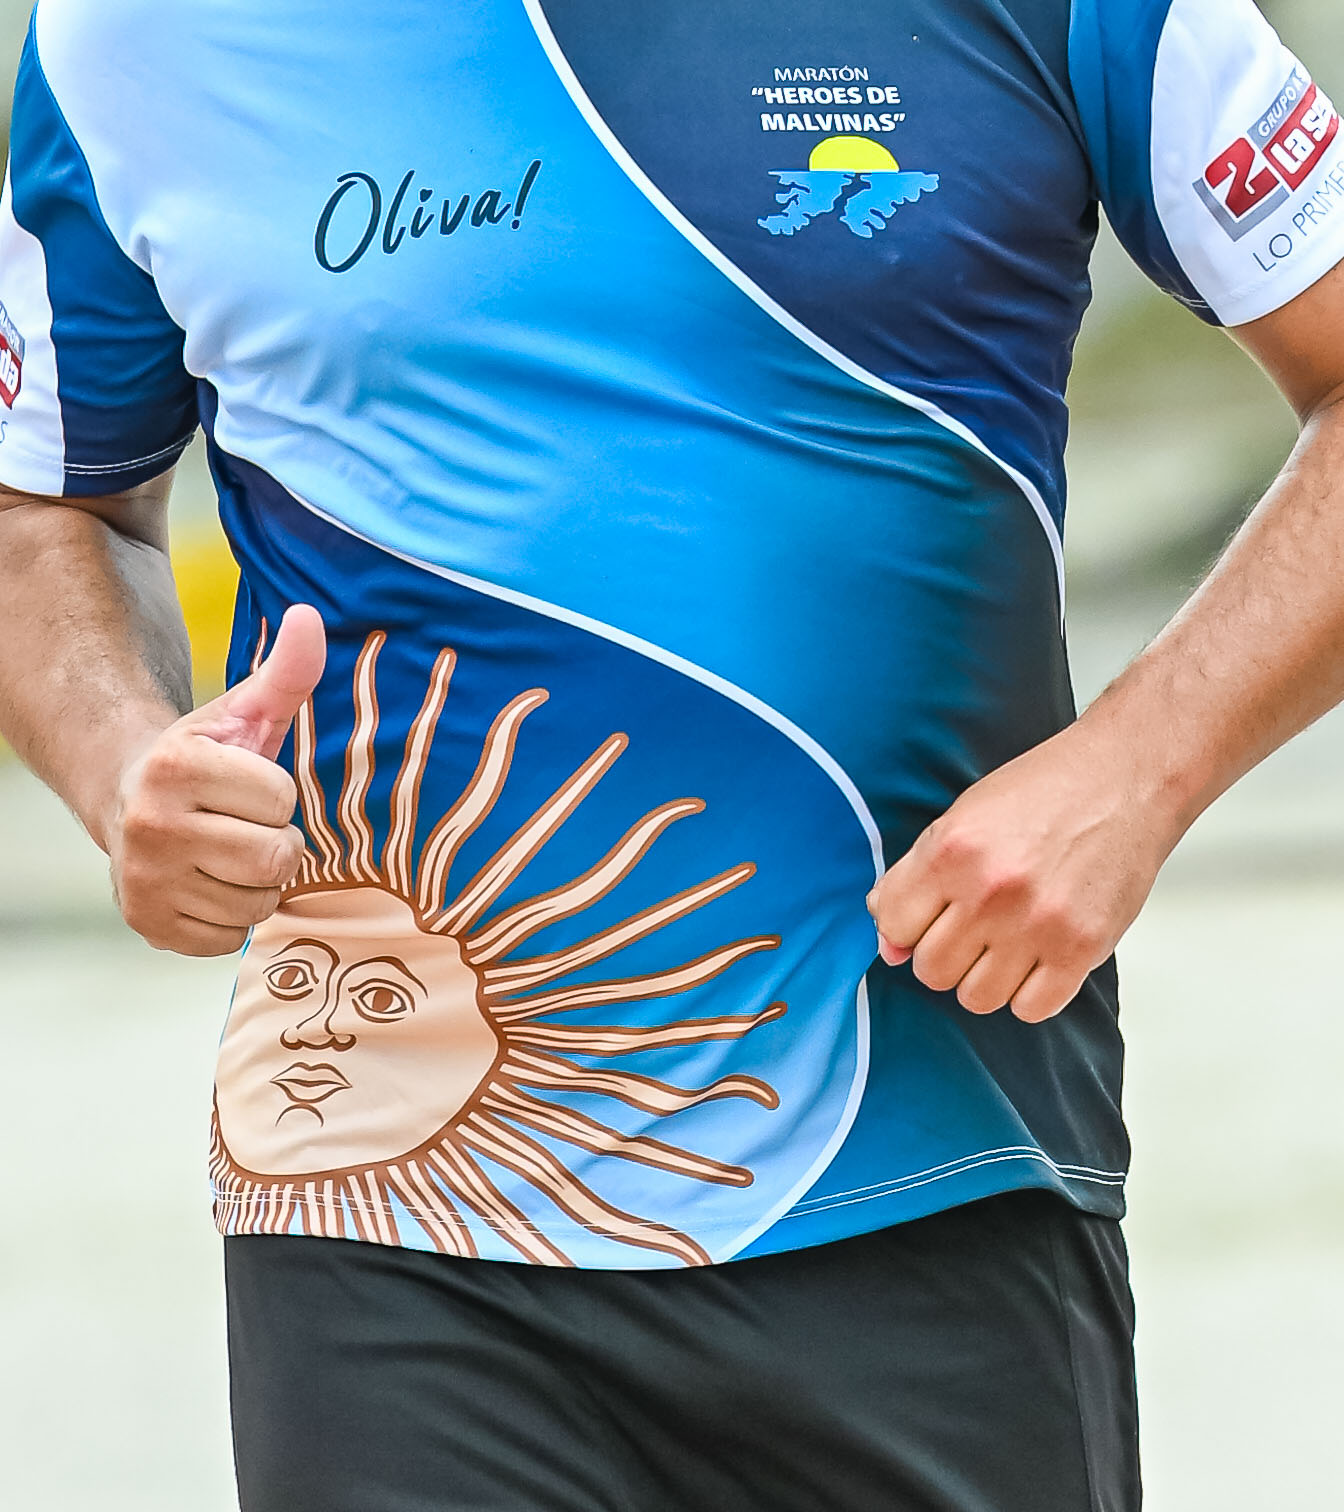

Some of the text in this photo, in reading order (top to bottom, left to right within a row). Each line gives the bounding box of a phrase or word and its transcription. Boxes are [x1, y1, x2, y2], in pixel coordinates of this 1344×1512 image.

[773, 65, 869, 82] MARATÓN
[751, 86, 901, 105] "HEROES DE
[760, 113, 906, 132] MALVINAS"
[1258, 87, 1296, 137] GRUPO
[313, 159, 542, 274] Oliva!
[1253, 233, 1293, 272] LO
